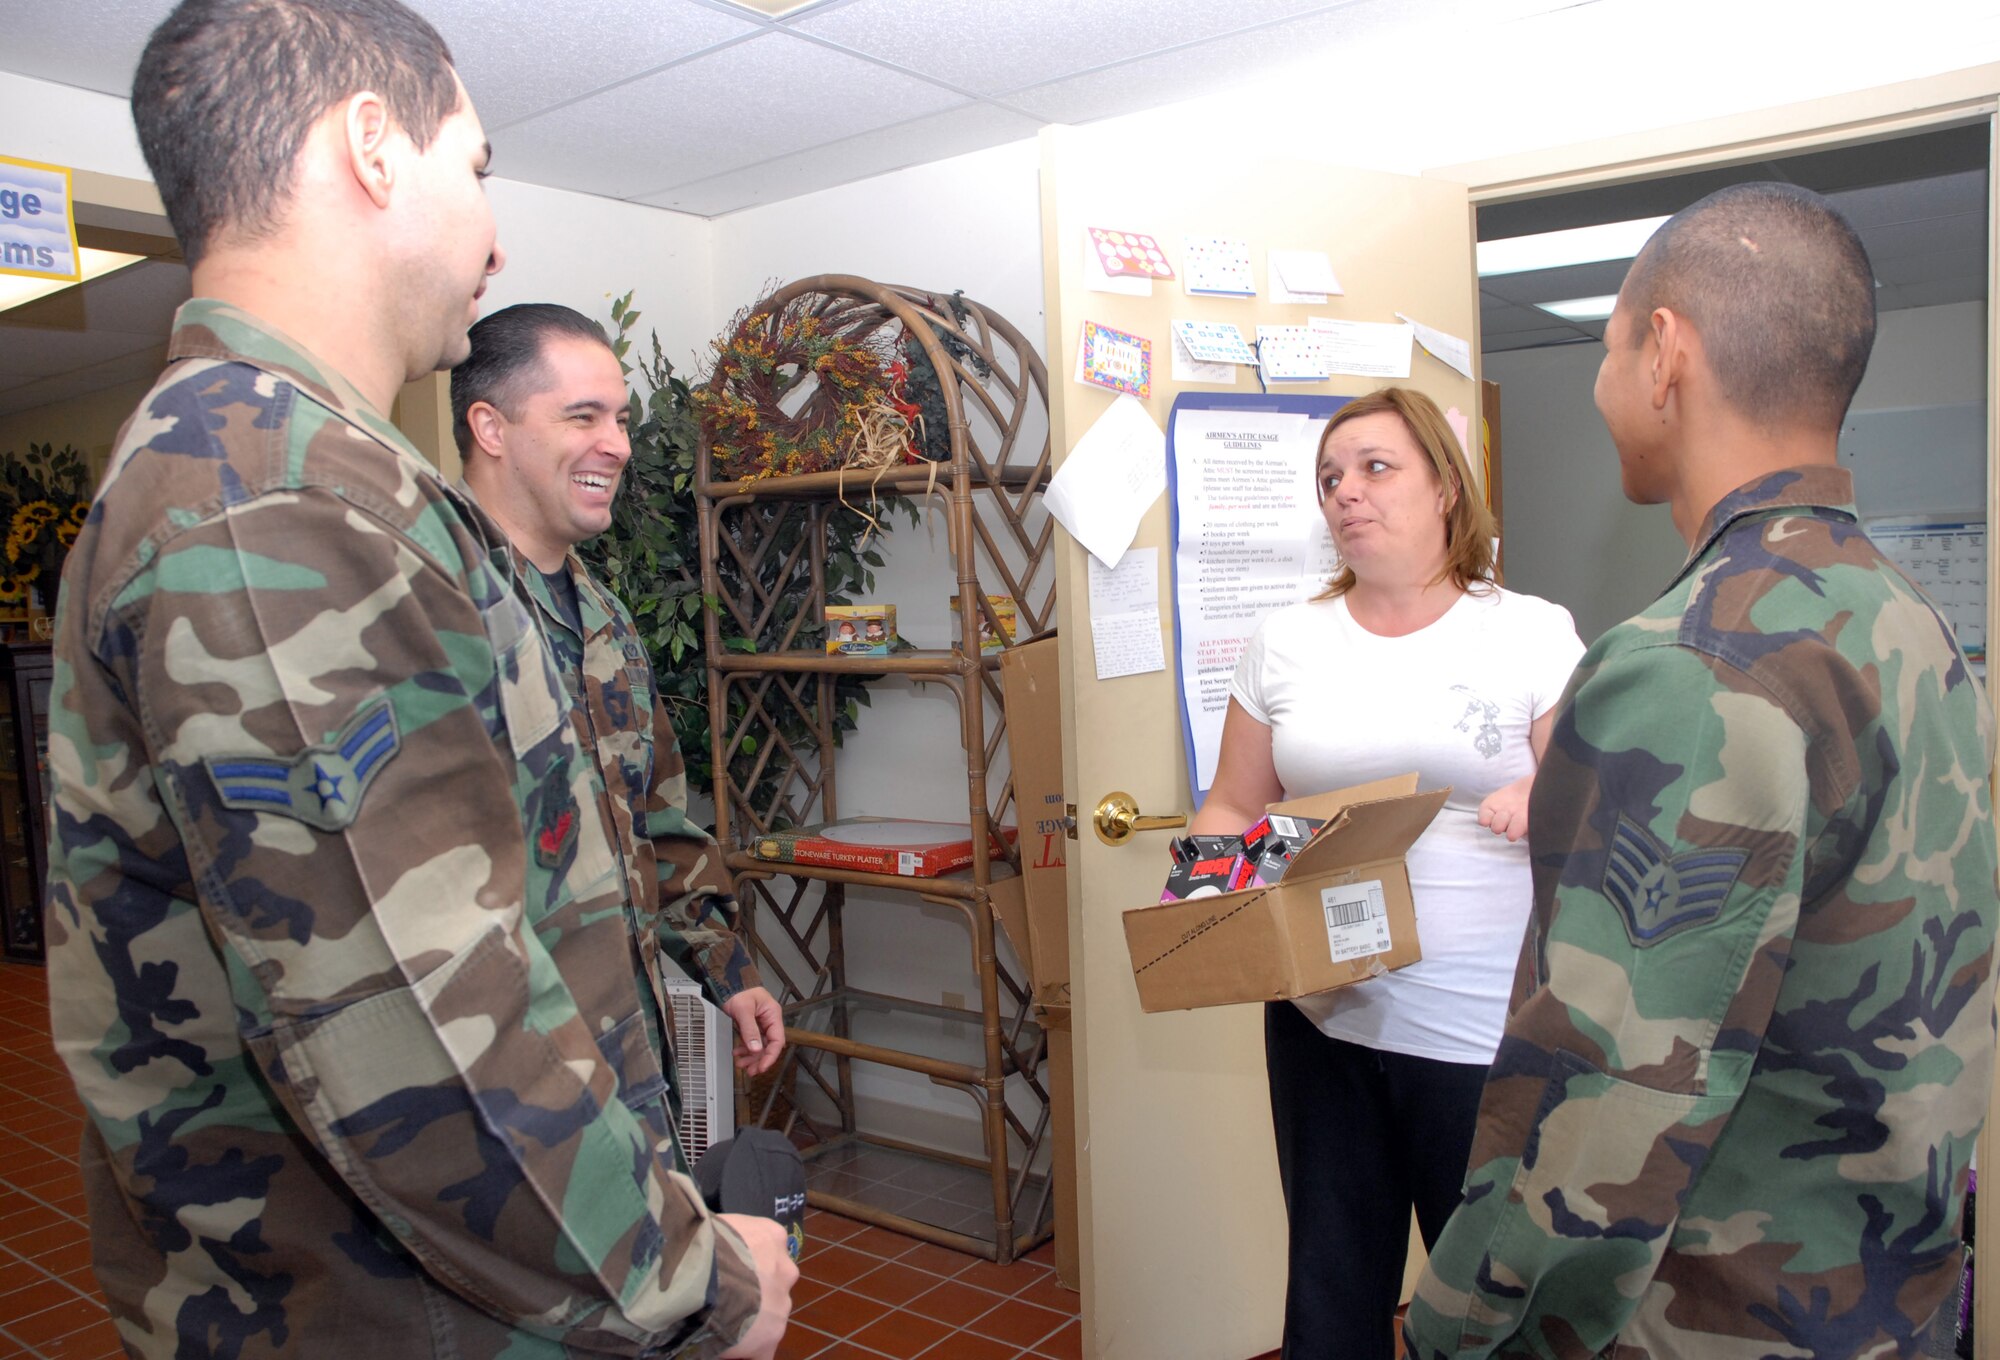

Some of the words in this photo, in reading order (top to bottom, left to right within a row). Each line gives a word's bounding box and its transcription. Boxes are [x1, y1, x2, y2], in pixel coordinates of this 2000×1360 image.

[0, 242, 55, 268] ms
[1224, 441, 1262, 450] GUIDELINES
[1198, 666, 1224, 675] guidelines
[794, 850, 831, 860] STONEWARE
[832, 853, 856, 862] TURKEY
[857, 856, 883, 865] PLATTER
